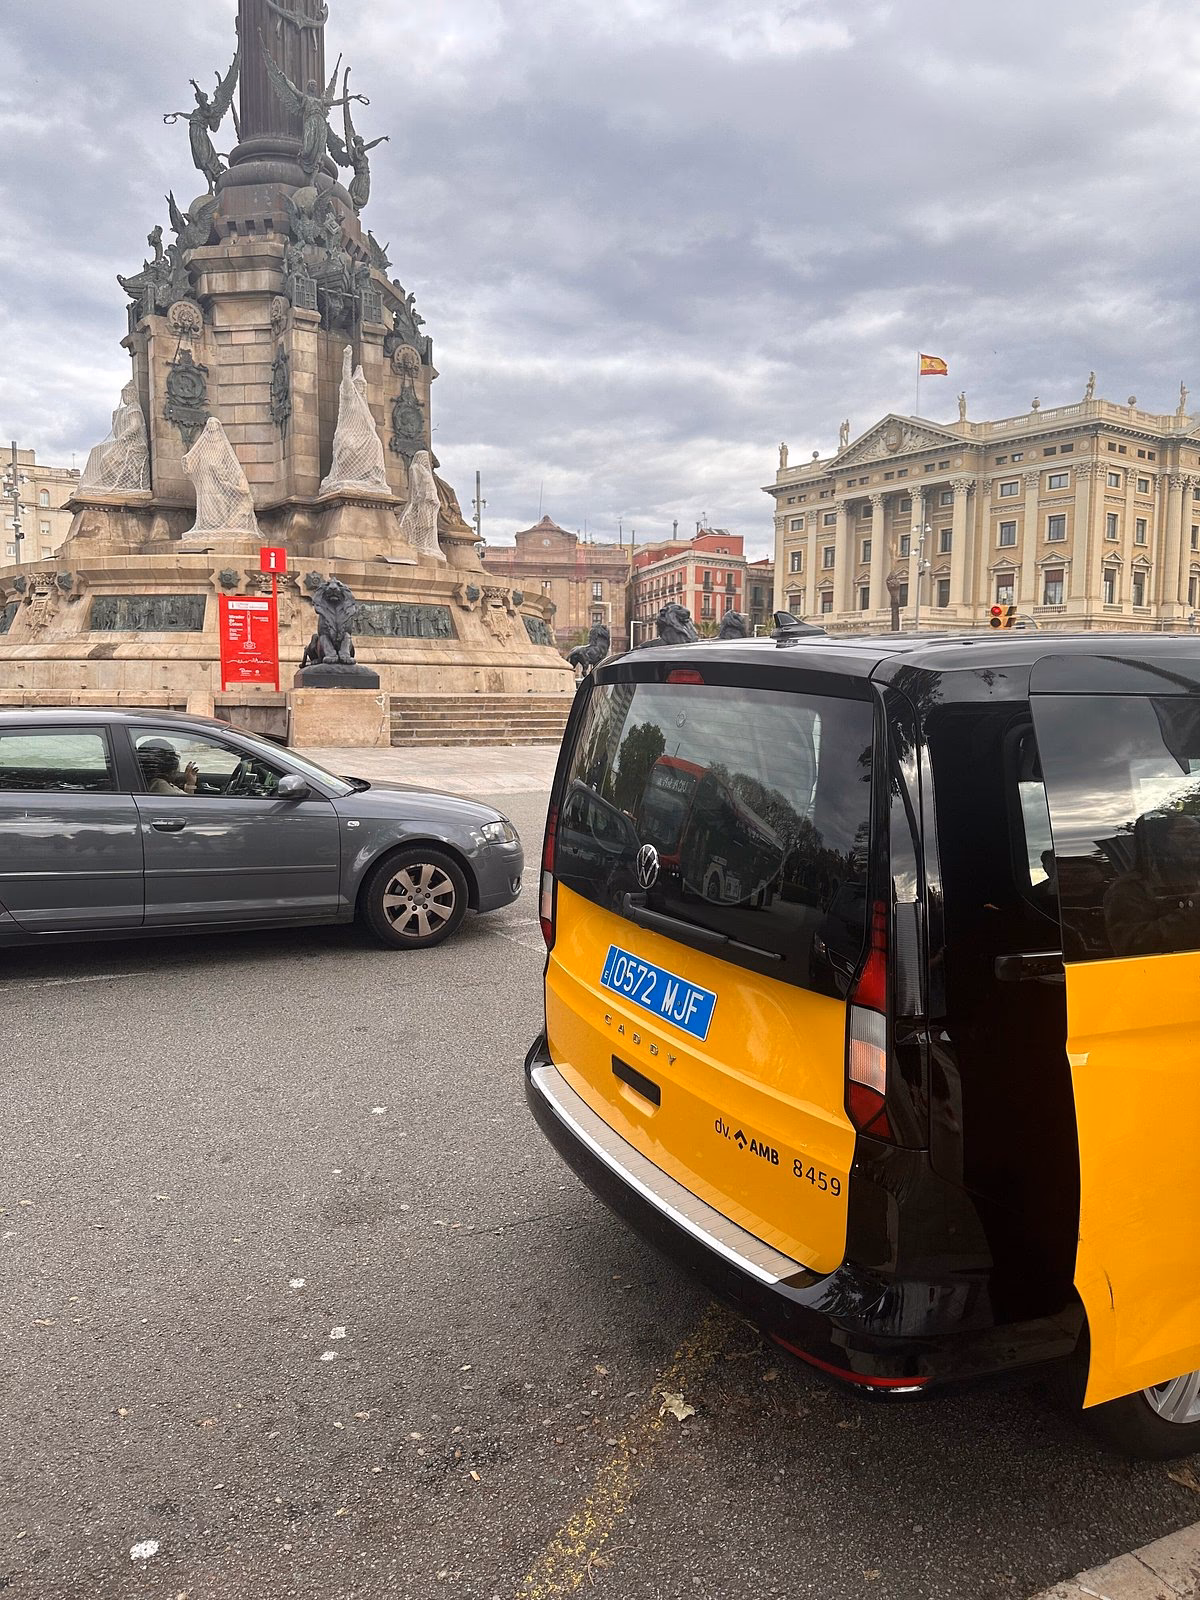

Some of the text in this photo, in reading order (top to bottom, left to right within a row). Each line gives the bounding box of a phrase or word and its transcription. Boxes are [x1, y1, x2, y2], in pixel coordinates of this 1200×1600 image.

[613, 956, 704, 1025] 0572 MJF
[604, 1013, 677, 1067] CADDY
[714, 1117, 842, 1197] dv. AMB 8459
